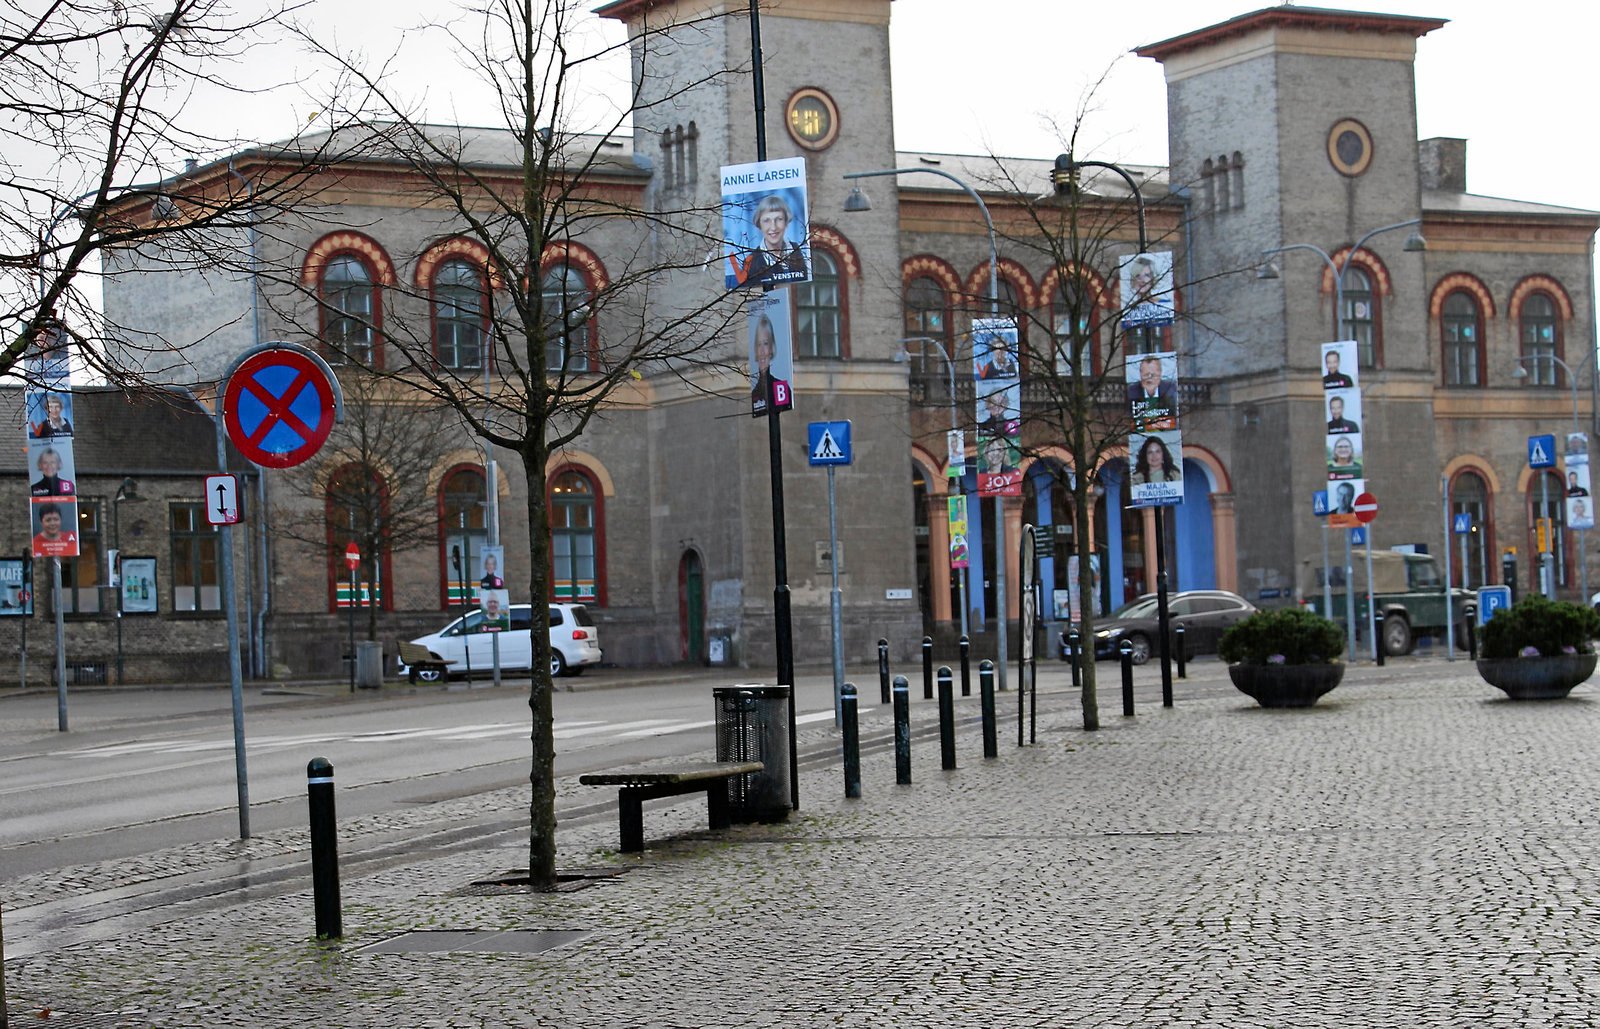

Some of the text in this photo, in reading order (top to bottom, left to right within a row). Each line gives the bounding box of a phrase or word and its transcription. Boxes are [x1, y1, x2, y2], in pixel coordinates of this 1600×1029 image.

[723, 168, 800, 187] ANNIE LARSEN
[773, 271, 805, 280] VENSTRE
[776, 384, 786, 402] B
[62, 482, 71, 491] B
[985, 475, 1013, 488] JOY
[1146, 482, 1168, 491] MAJA
[1137, 489, 1177, 498] FRAUSING
[1490, 597, 1498, 610] P
